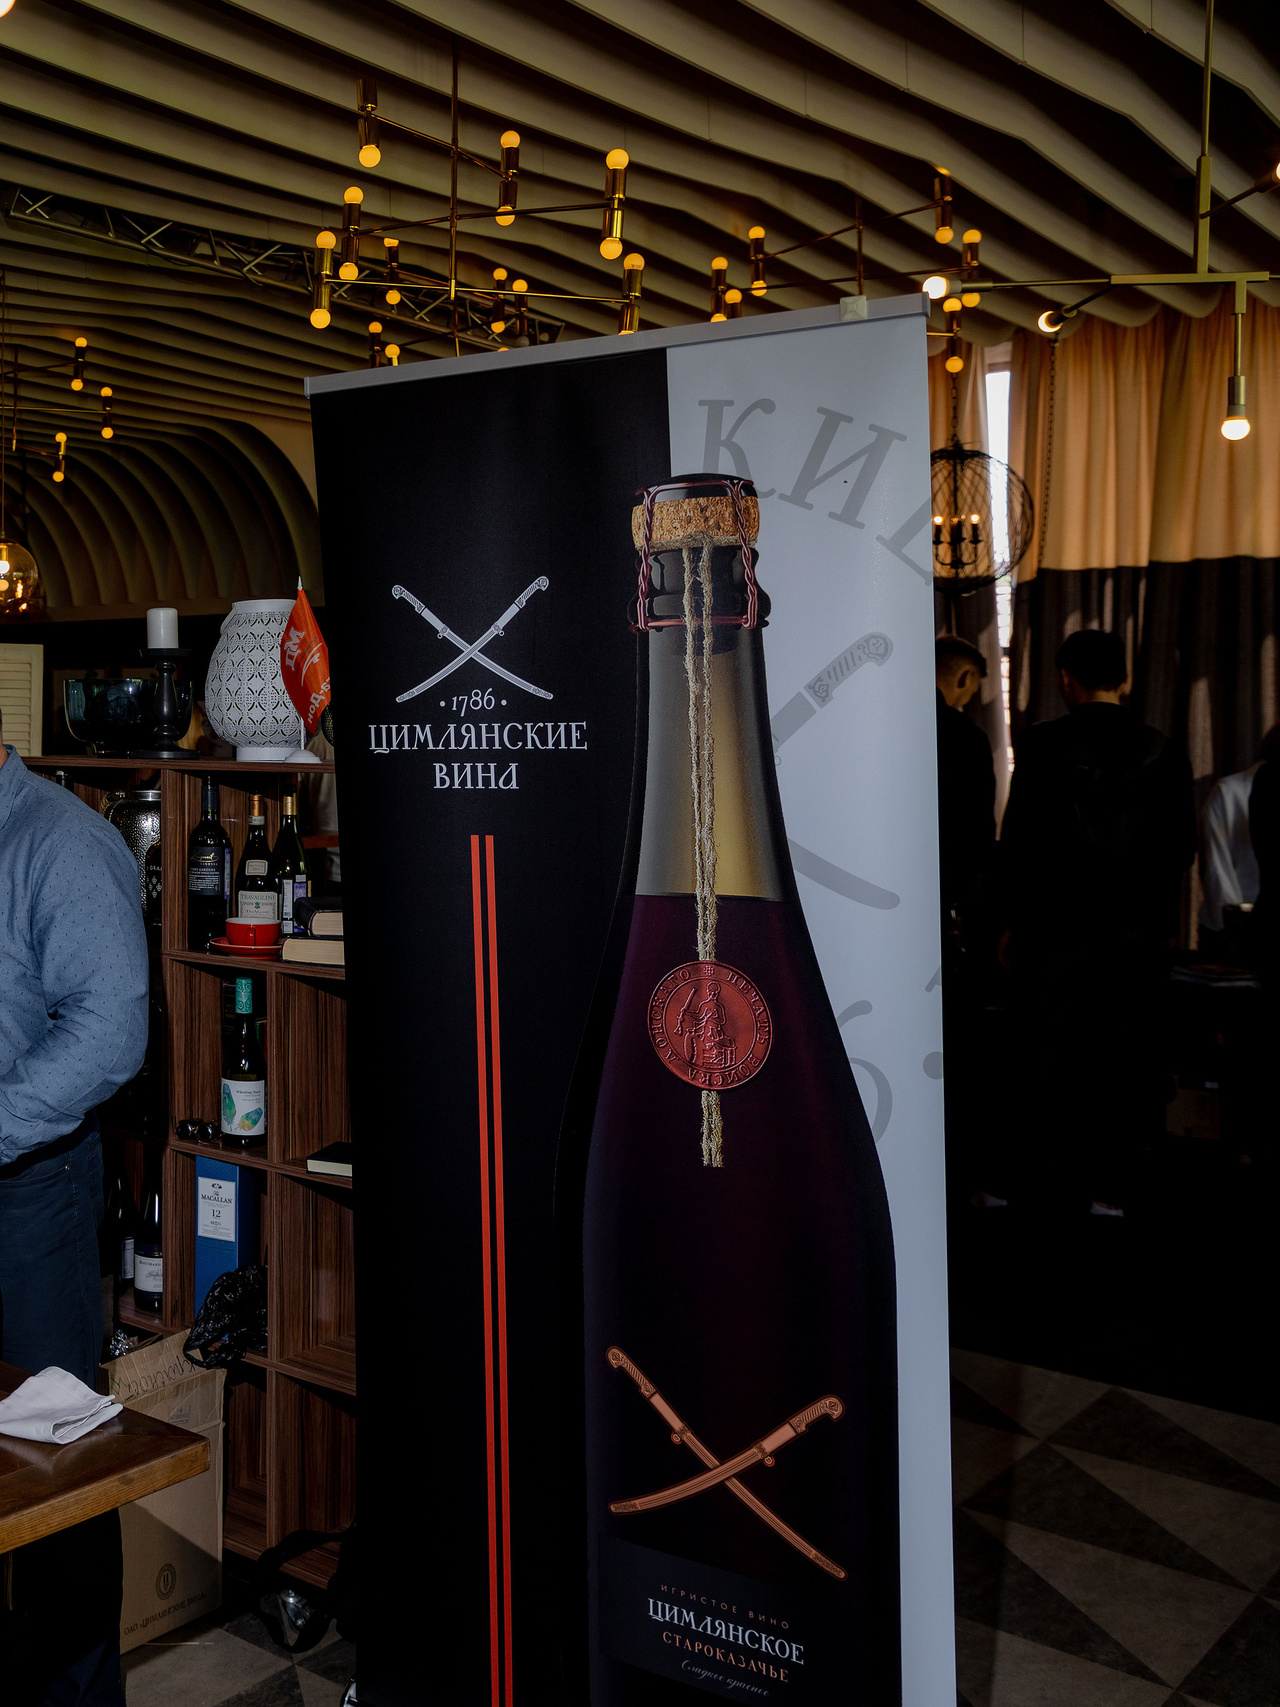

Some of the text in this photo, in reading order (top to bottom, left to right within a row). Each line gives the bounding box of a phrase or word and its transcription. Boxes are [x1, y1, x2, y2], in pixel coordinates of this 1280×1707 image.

[451, 687, 495, 717] 1786
[368, 721, 588, 754] ЦИМЛЯНСКИЕ
[433, 762, 519, 790] ВИНА
[201, 1193, 233, 1204] MACALLAN
[212, 1209, 221, 1218] 12
[660, 1584, 789, 1630] ИГРИСТОЕ ВИНО
[647, 1597, 804, 1666] ЦИМЛЯНСКОЕ
[662, 1631, 789, 1683] СТАРОКАЗАЧЬЕ
